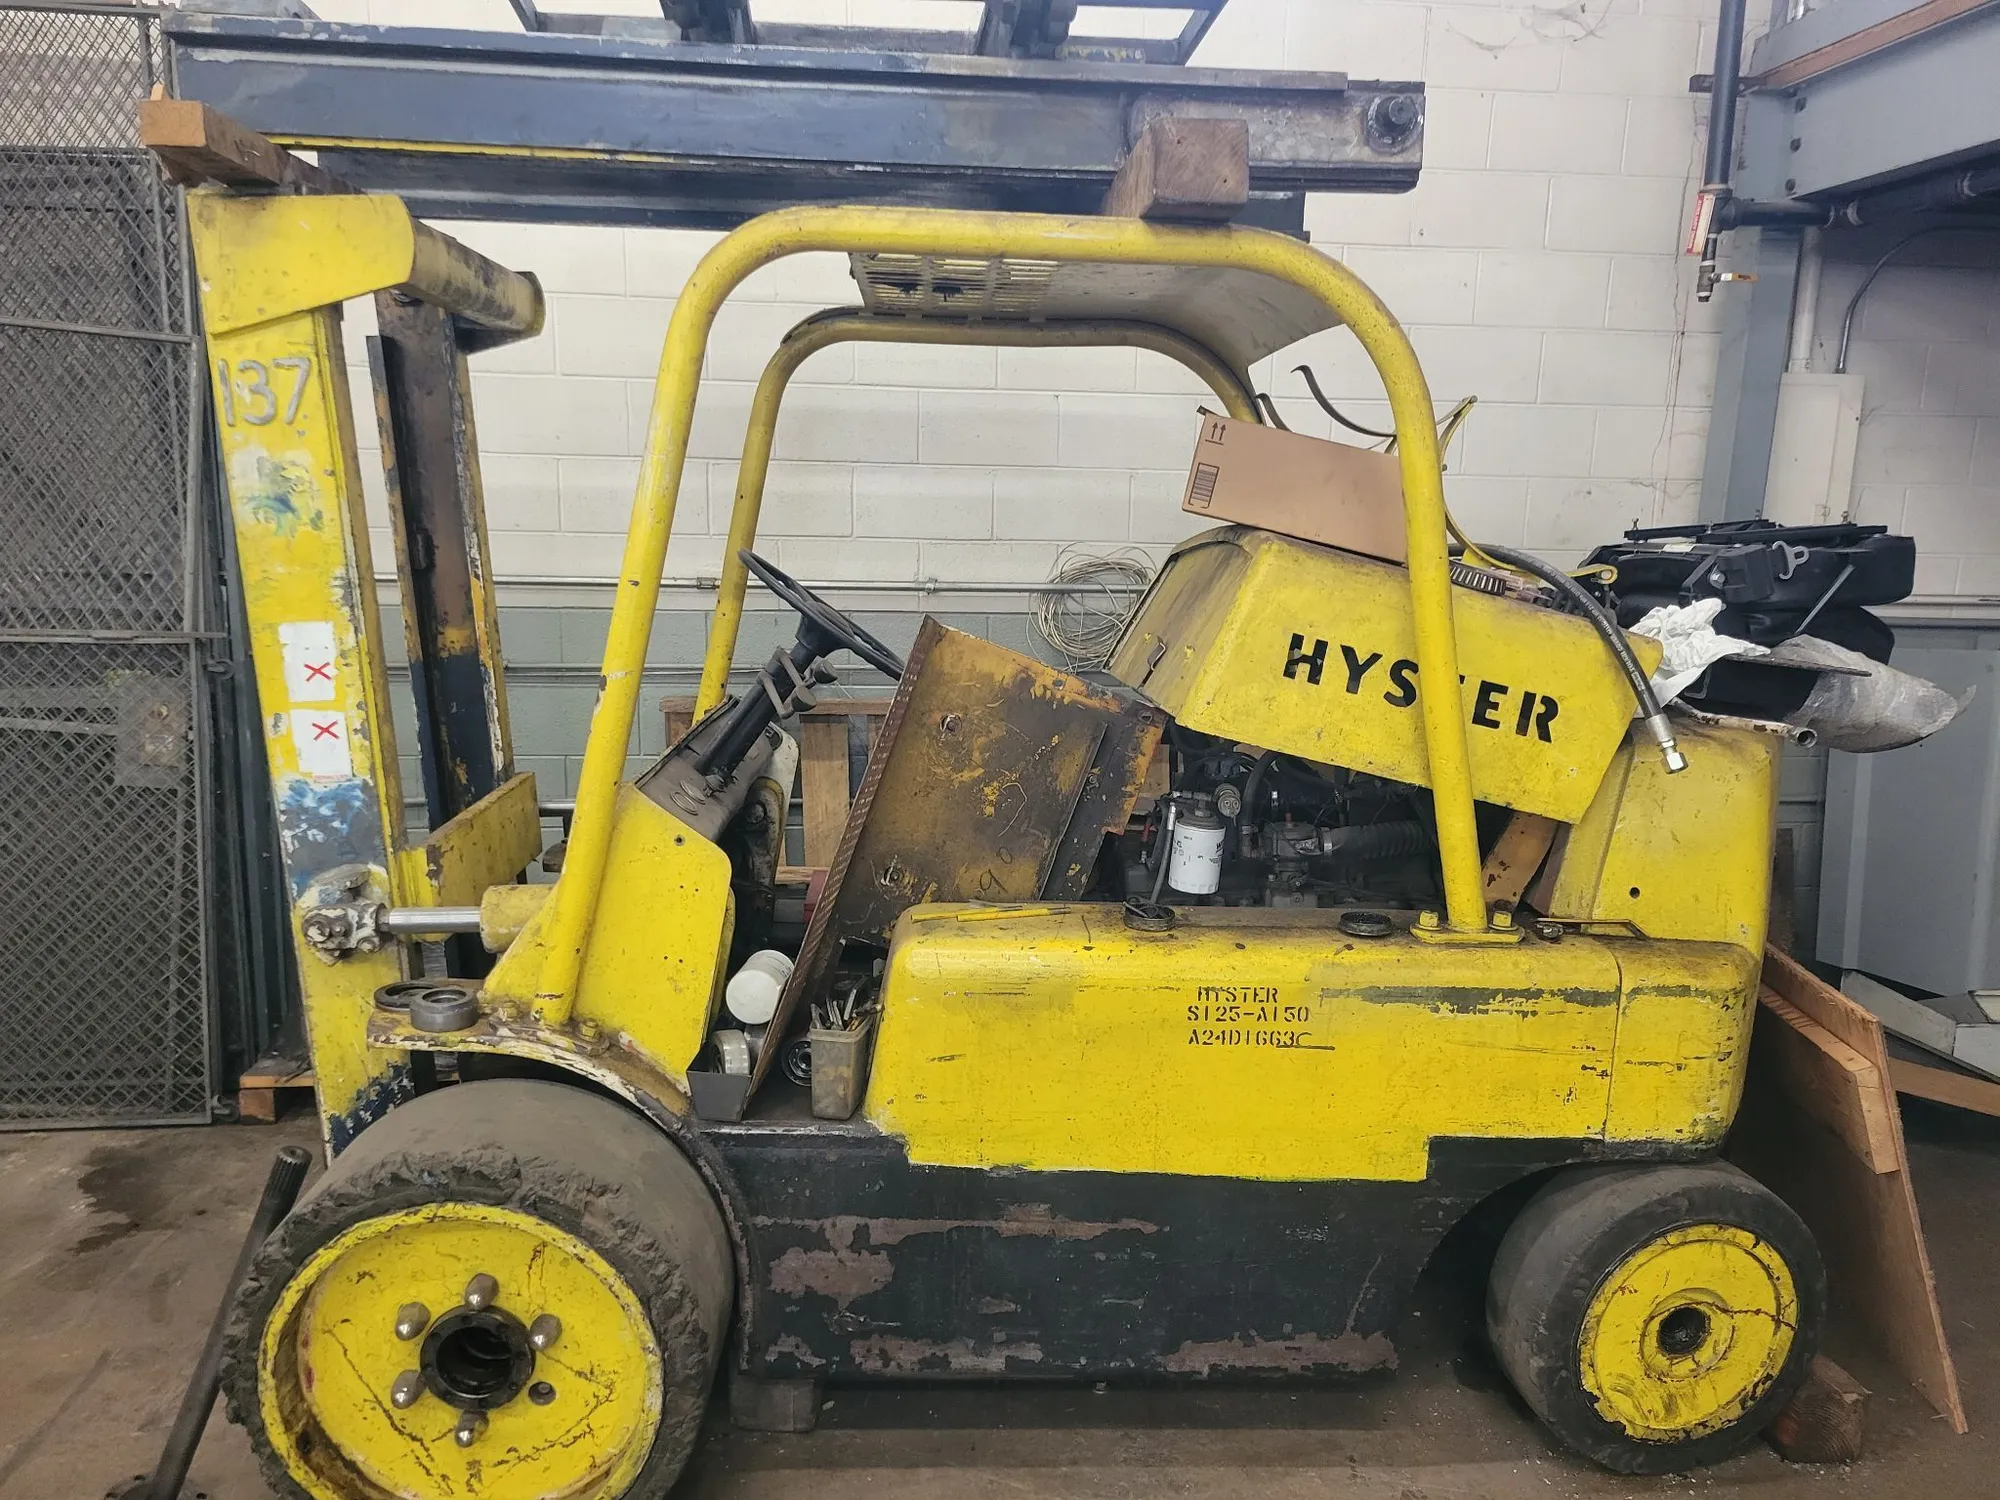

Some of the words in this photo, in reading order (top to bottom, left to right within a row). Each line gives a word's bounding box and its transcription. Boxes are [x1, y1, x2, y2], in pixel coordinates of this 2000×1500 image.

[217, 356, 311, 428] 137
[1282, 632, 1560, 744] HYSER
[1187, 1005, 1309, 1022] S125-A150
[1197, 986, 1278, 1003] HYSTER
